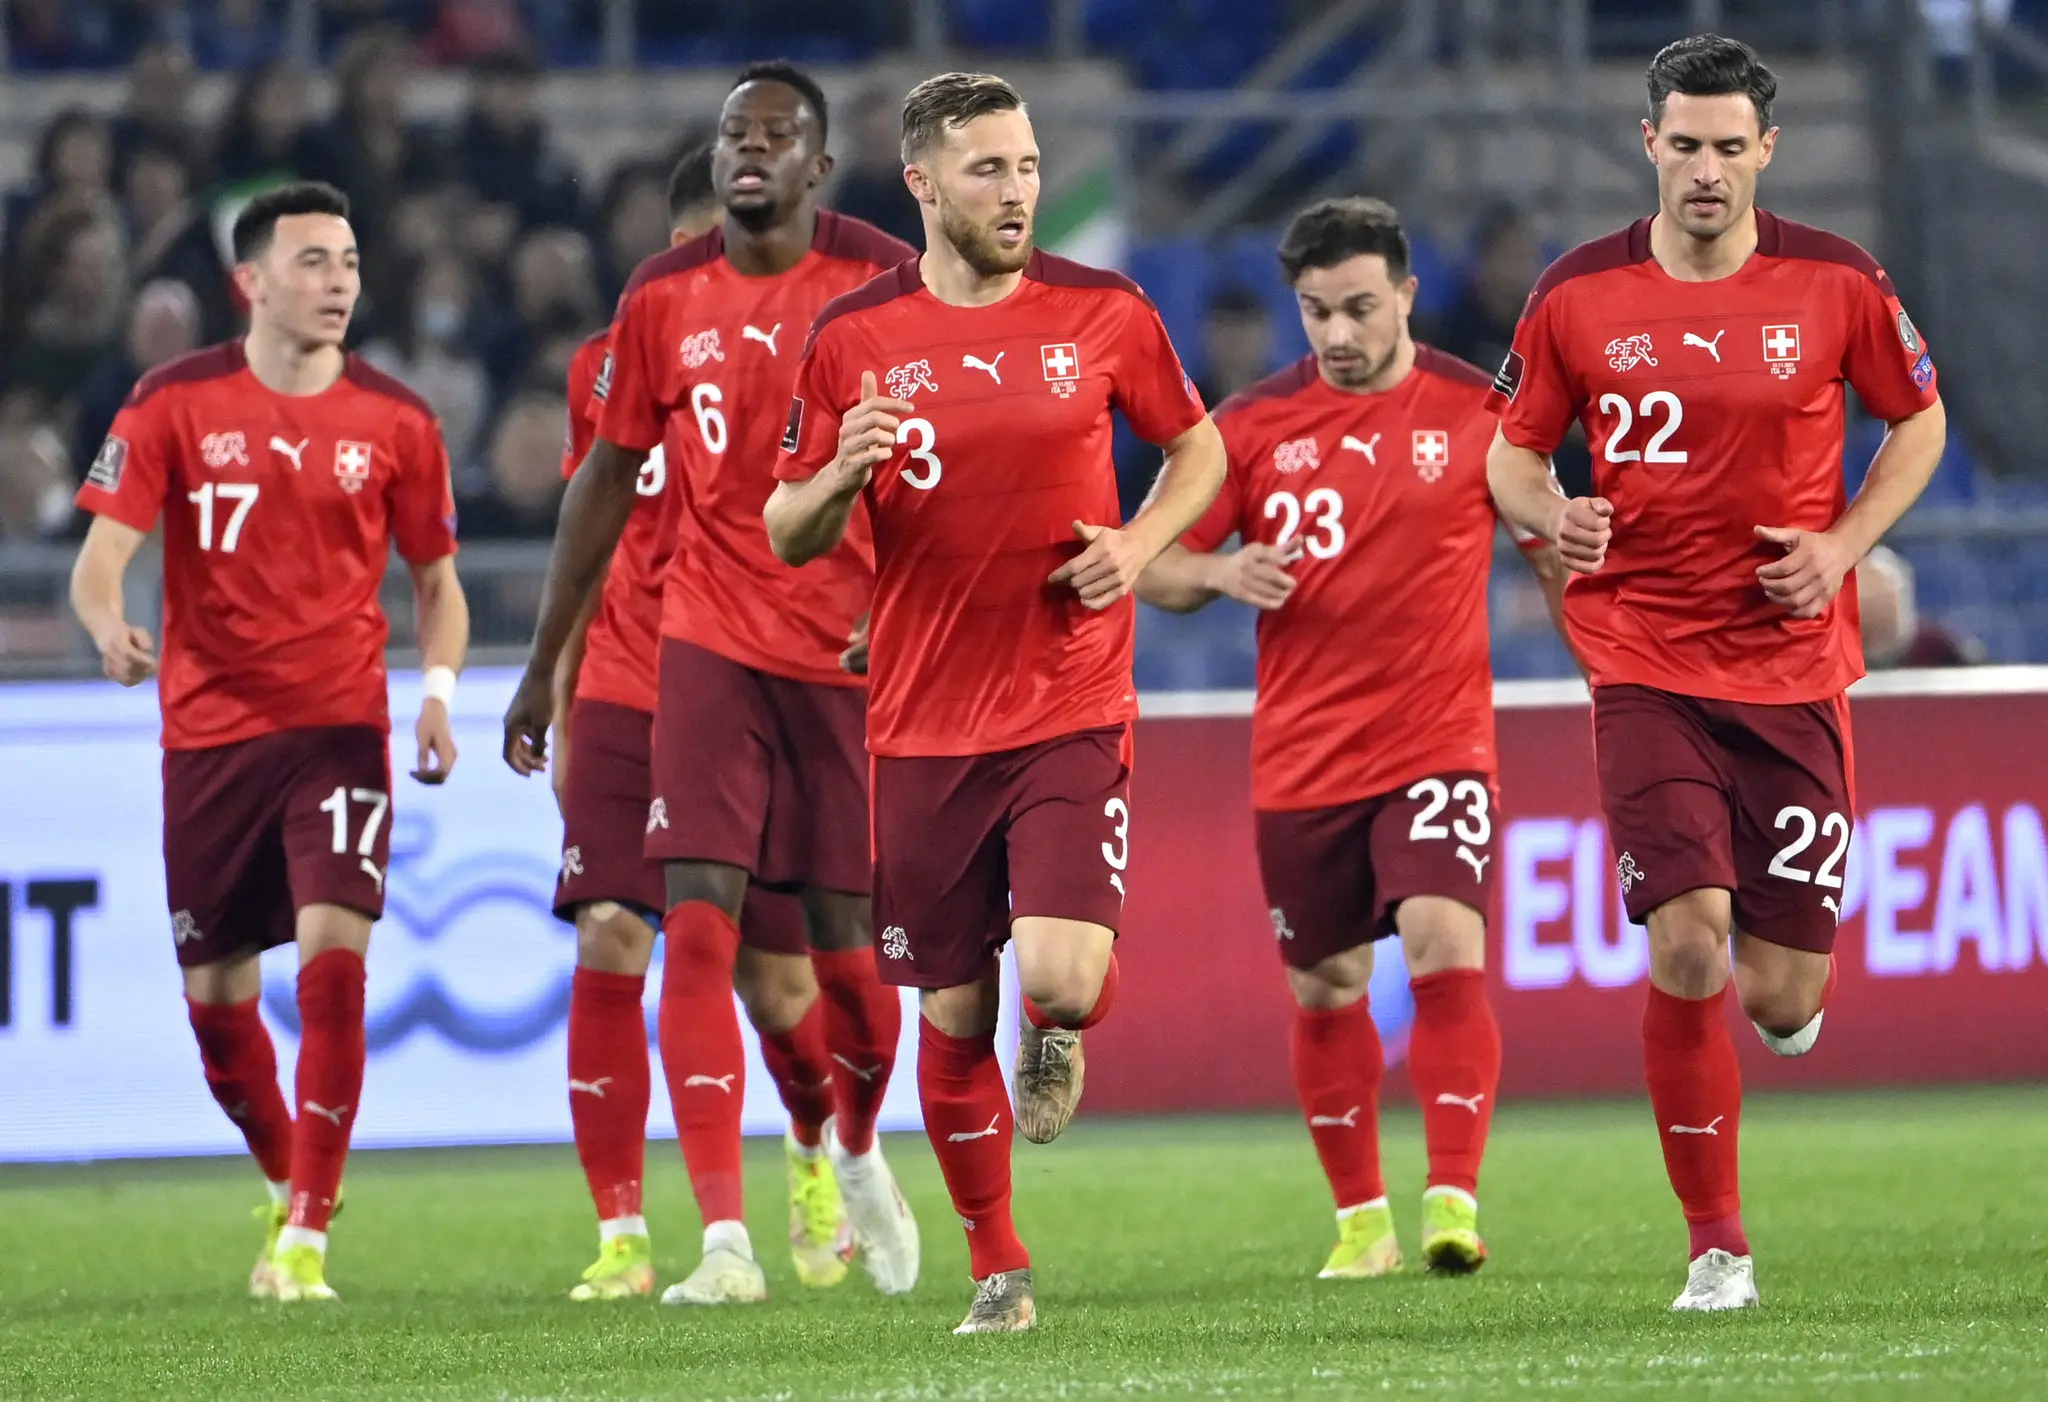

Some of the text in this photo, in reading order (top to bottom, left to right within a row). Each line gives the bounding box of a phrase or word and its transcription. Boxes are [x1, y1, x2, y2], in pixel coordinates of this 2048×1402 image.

[691, 382, 728, 455] 6
[896, 416, 942, 490] 3
[1599, 390, 1688, 464] 22
[188, 481, 260, 554] 17
[1263, 487, 1346, 560] 23
[319, 786, 389, 857] 17
[1101, 797, 1129, 872] 3
[1406, 777, 1491, 846] 23
[1767, 804, 1850, 890] 22
